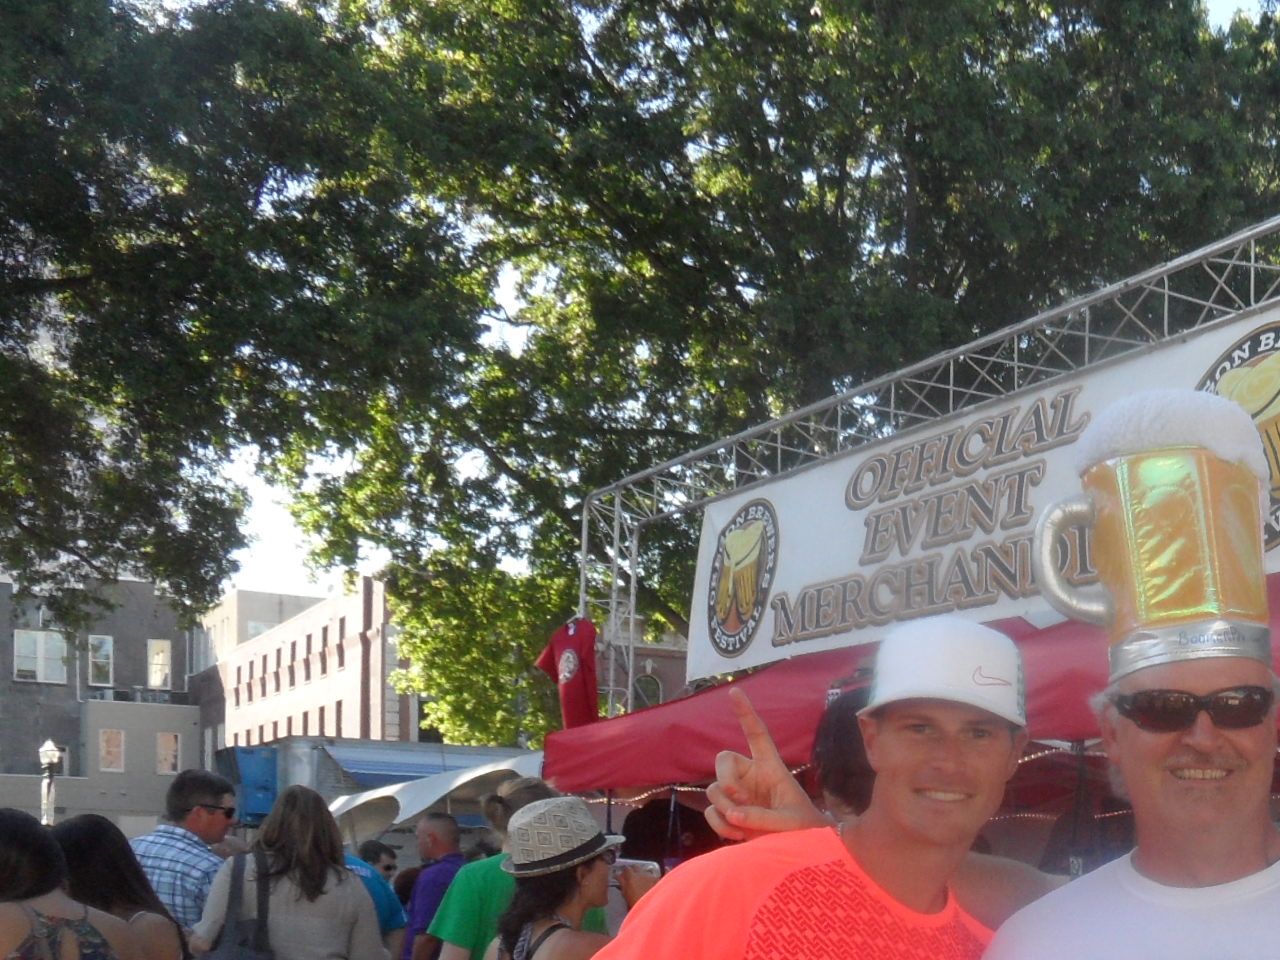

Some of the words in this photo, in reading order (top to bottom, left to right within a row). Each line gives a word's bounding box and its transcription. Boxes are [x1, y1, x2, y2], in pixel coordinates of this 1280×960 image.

[847, 388, 1090, 509] OFFICIAL
[860, 430, 1046, 565] EVENT
[773, 526, 1097, 645] MERCHANDI
